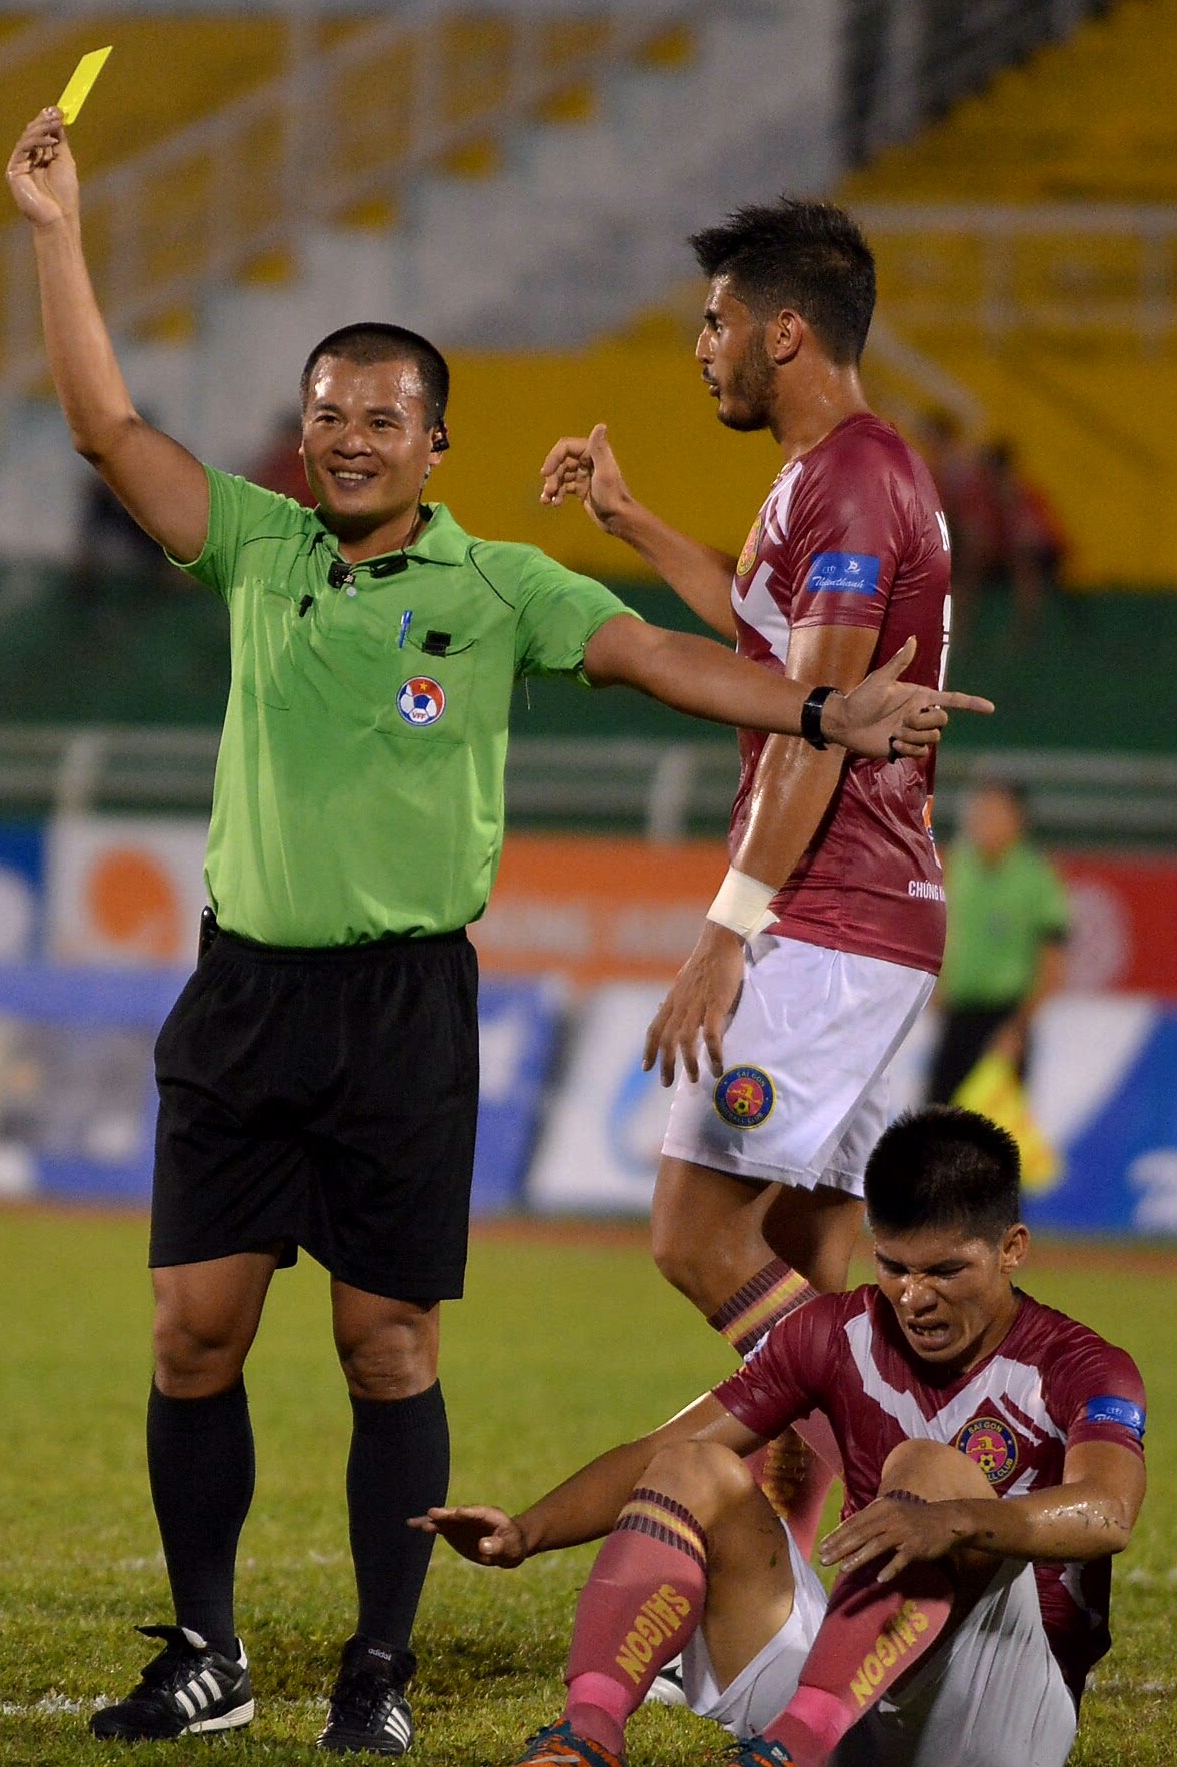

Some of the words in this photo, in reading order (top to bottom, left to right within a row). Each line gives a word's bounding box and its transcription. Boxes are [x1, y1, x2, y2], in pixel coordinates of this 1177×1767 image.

[412, 711, 427, 720] VFF
[983, 1420, 1003, 1433] GON
[615, 1584, 691, 1685] SAIGON
[849, 1599, 929, 1707] SAIGON
